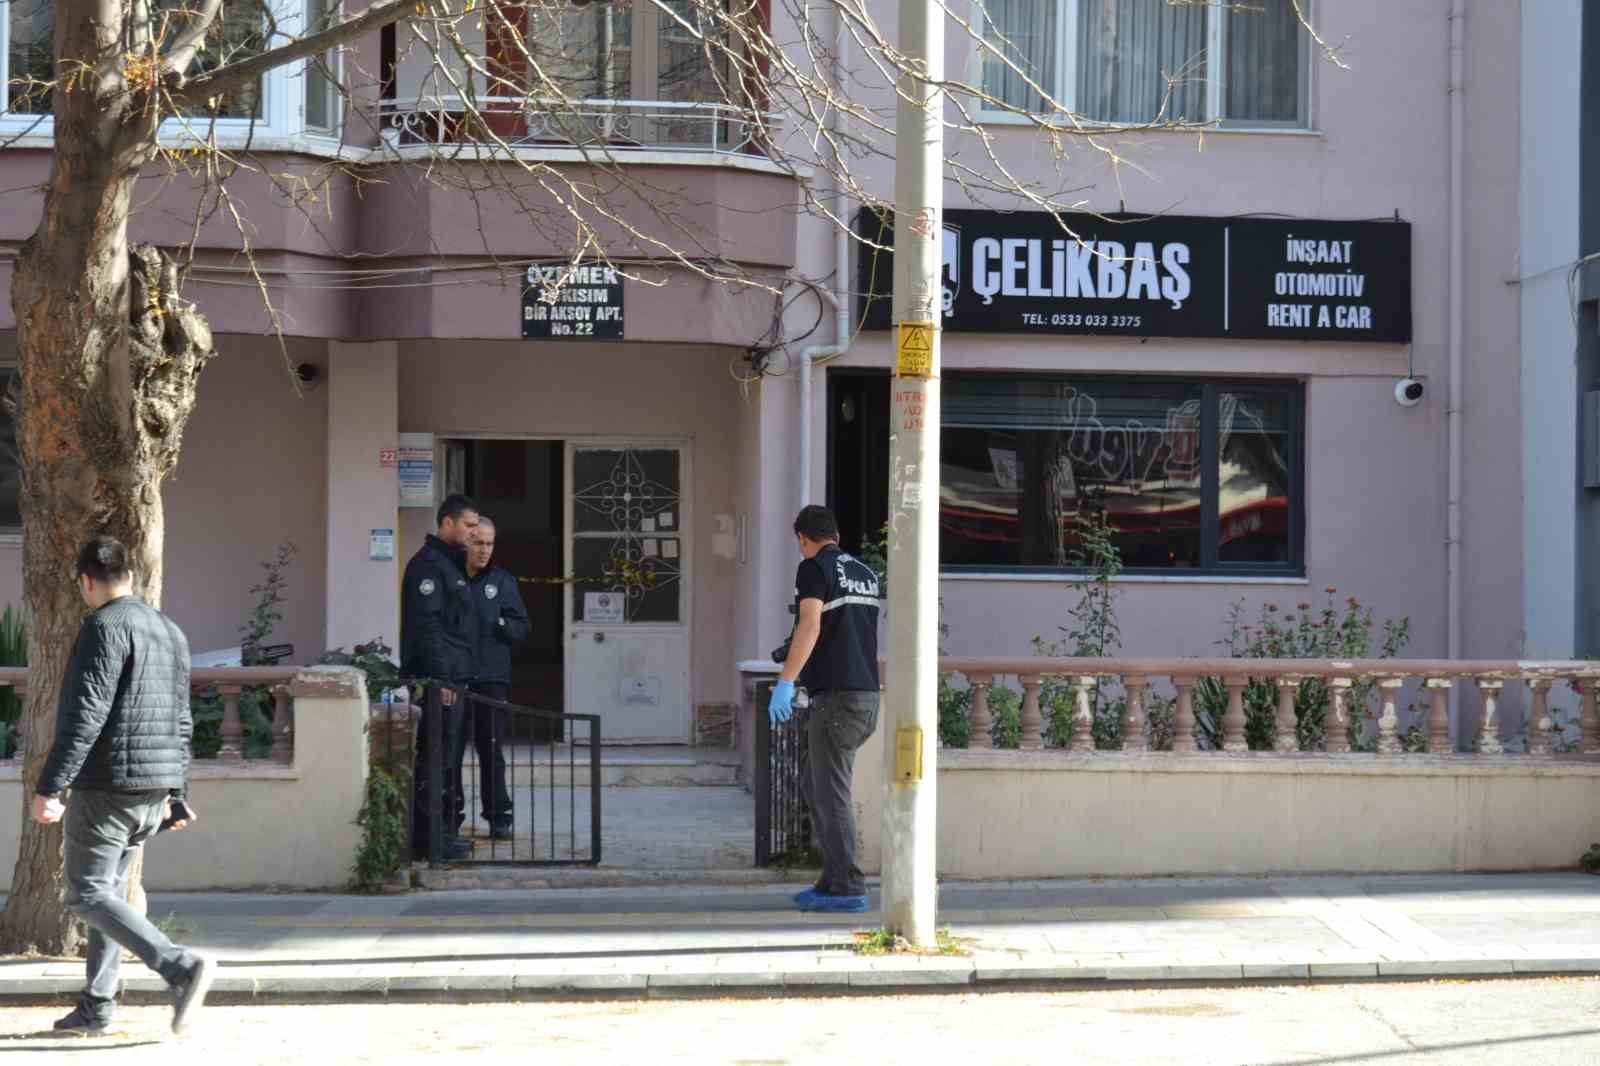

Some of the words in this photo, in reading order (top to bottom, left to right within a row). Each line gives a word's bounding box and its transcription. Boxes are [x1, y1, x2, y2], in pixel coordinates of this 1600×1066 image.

[1286, 233, 1353, 266] İNŞAAT
[1275, 269, 1365, 297] OTOMOTİV
[550, 306, 591, 321] AKSOY
[596, 306, 623, 321] APT.
[1022, 313, 1048, 325] TEL:
[1051, 313, 1082, 326] 0533
[1085, 315, 1108, 326] 033
[1111, 315, 1142, 327] 3375
[1267, 303, 1313, 328] RENT
[1317, 304, 1331, 328] A
[1335, 305, 1371, 329] CAR
